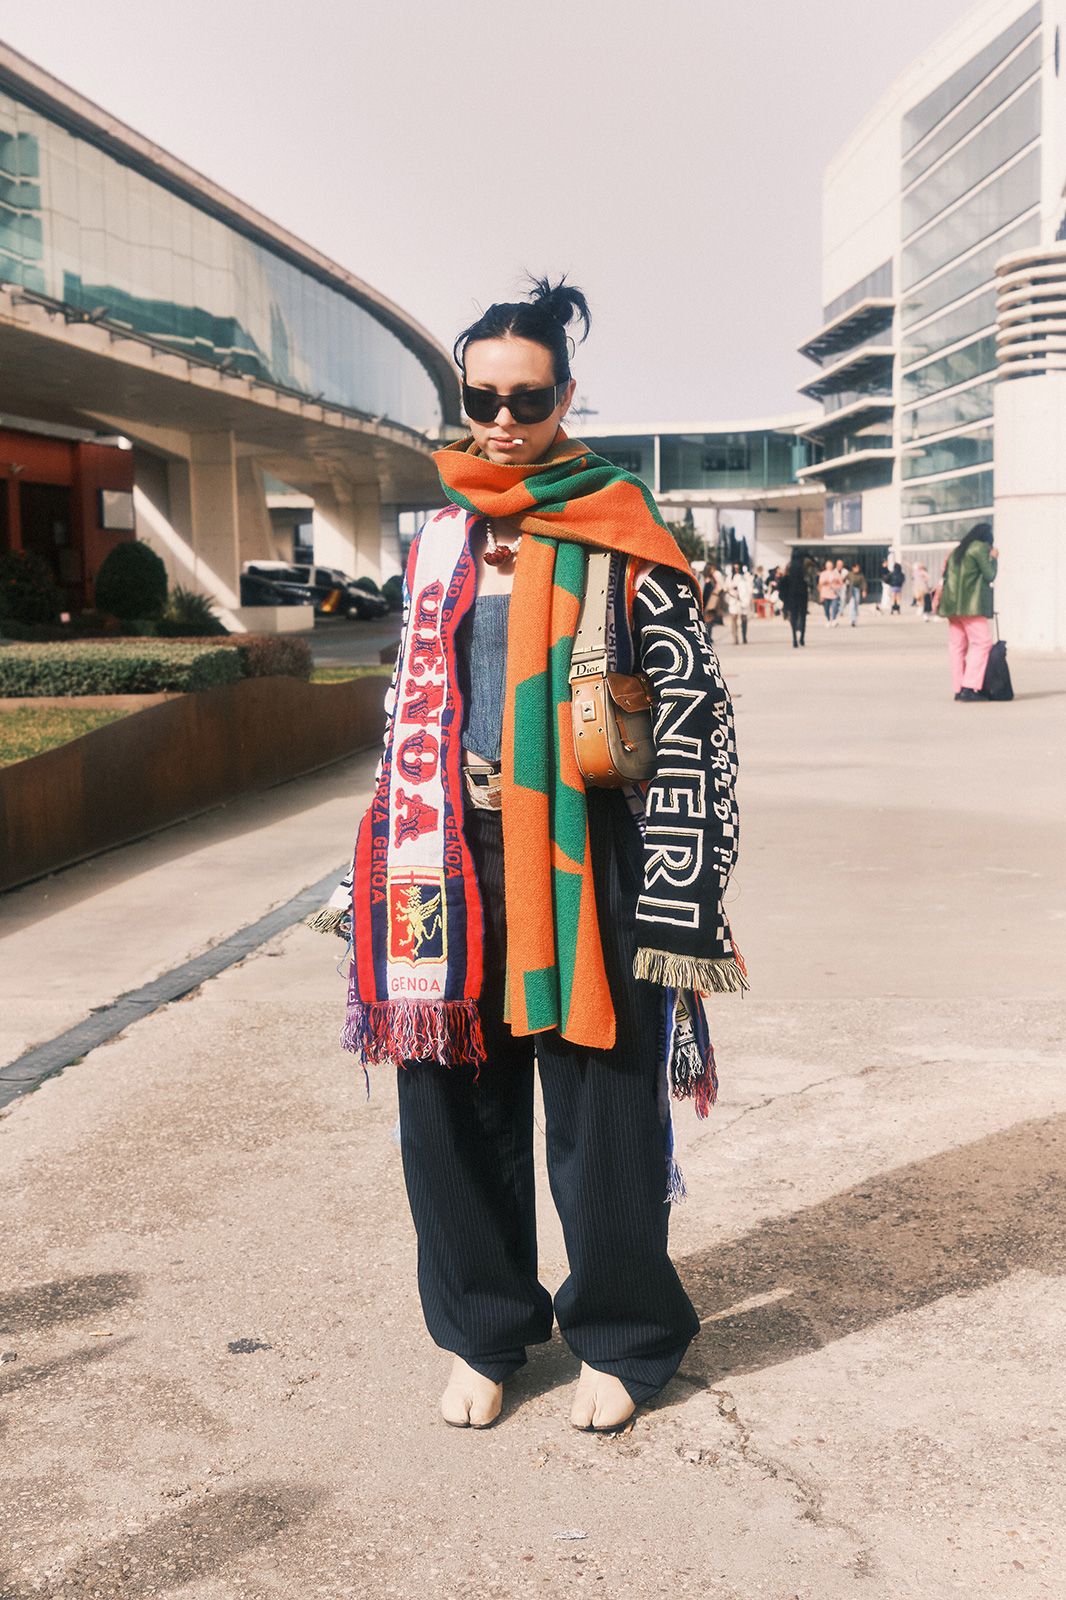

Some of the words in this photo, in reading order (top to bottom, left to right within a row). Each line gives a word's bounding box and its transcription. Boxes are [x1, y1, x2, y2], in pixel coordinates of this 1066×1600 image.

[576, 663, 600, 676] Dior
[710, 700, 731, 821] WORLD
[373, 762, 391, 824] FORZA
[371, 837, 388, 904] GENOA
[445, 815, 463, 880] GENOA
[390, 975, 441, 993] GENOA
